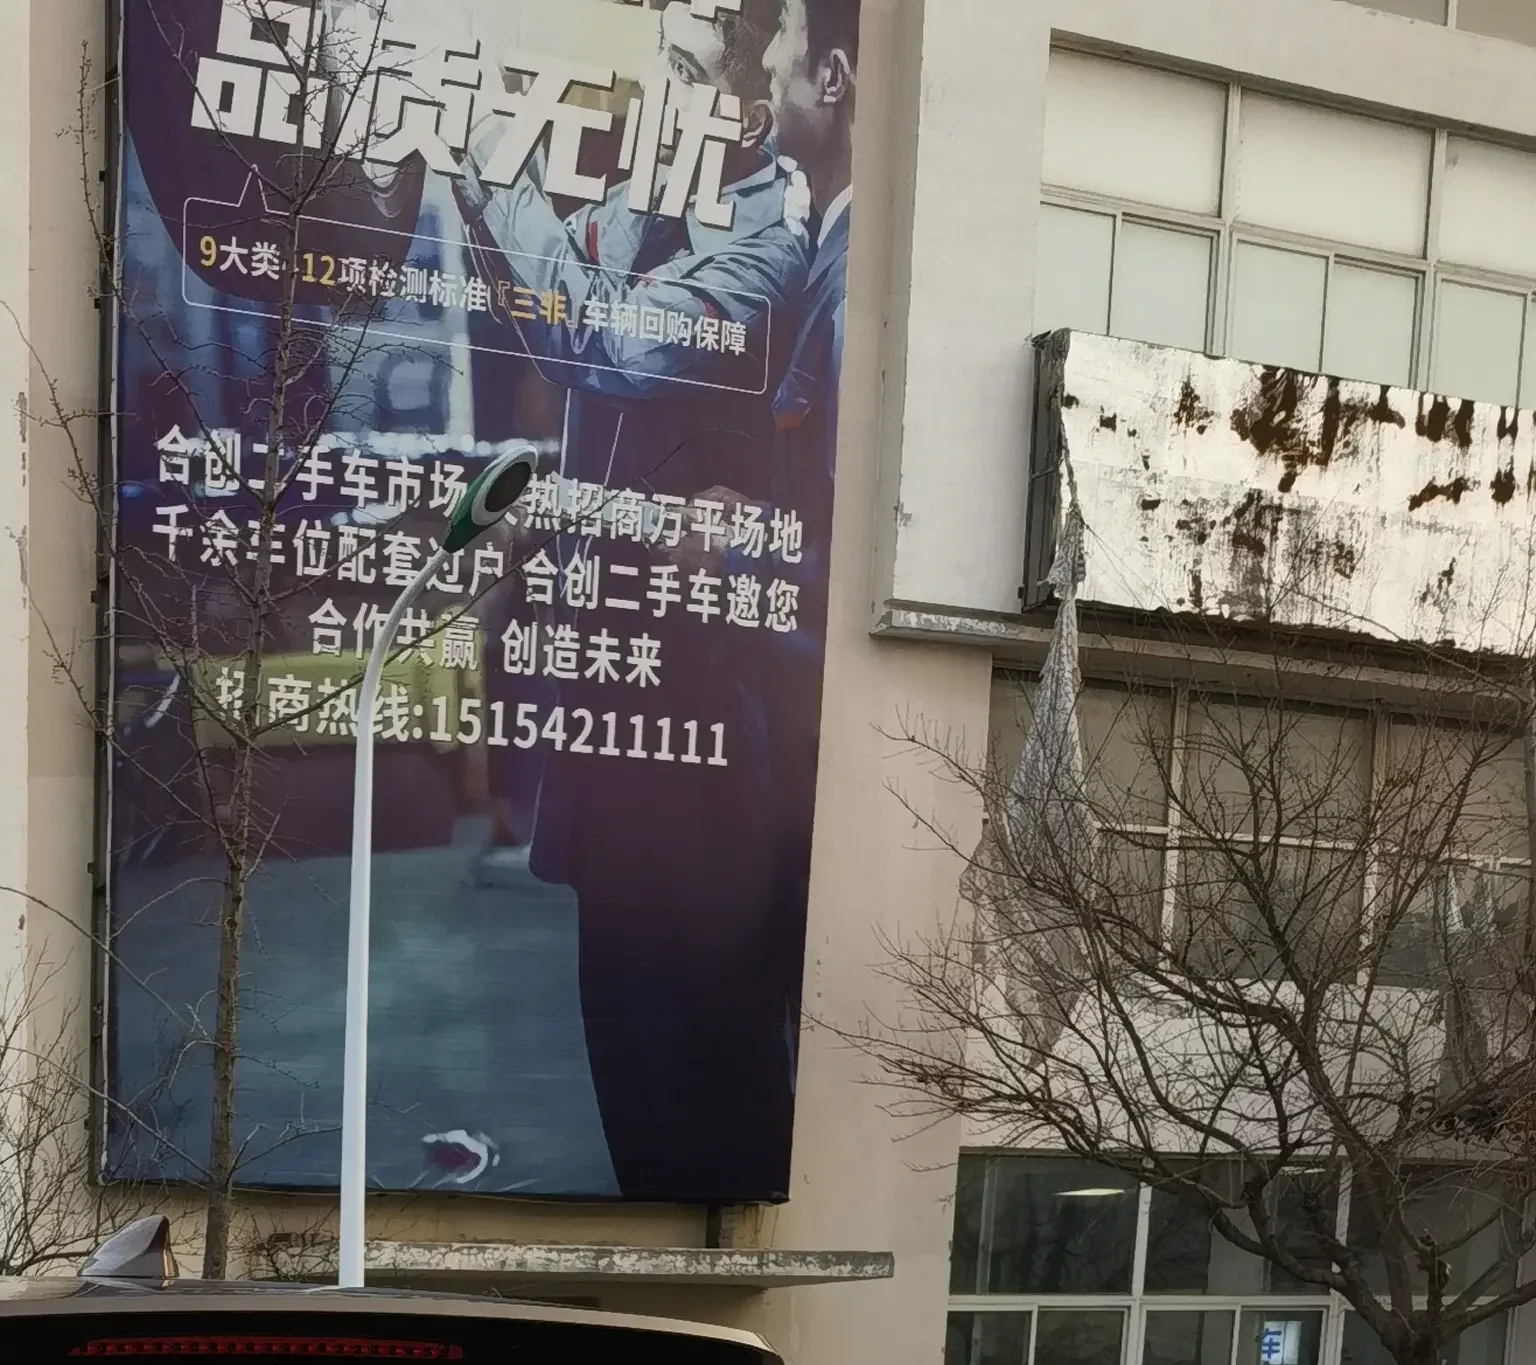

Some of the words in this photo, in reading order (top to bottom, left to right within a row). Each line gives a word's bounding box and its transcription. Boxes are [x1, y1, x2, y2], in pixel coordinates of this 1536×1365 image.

[190, 0, 744, 231] 品质无忧
[156, 424, 803, 564] 合创二手车市场热招商万平场地
[152, 504, 504, 598] 千余车位配套过户
[522, 548, 800, 633] 合创二手车邀您
[308, 597, 480, 671] 合作共赢
[500, 618, 663, 688] 创造未来
